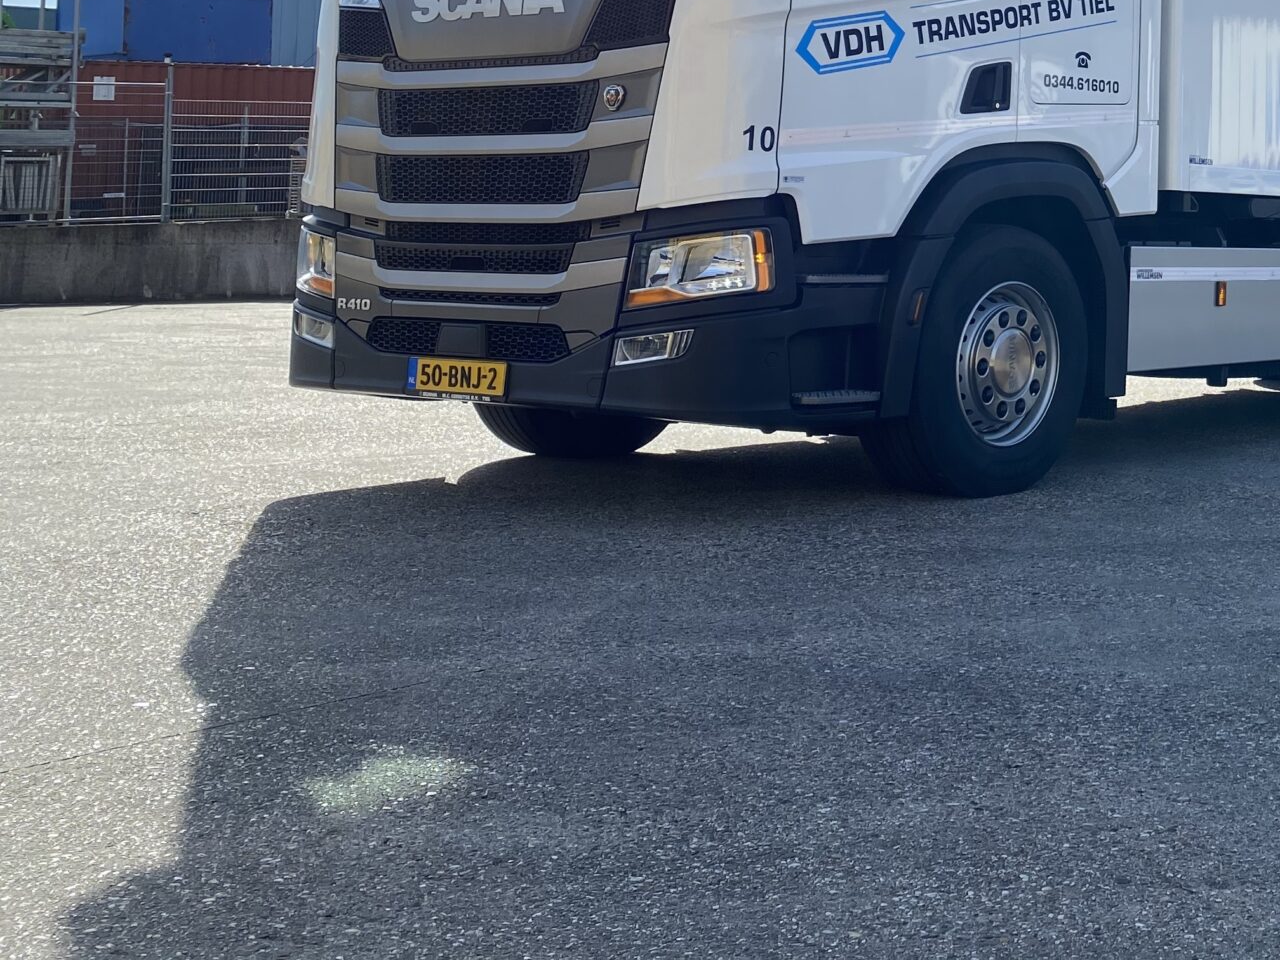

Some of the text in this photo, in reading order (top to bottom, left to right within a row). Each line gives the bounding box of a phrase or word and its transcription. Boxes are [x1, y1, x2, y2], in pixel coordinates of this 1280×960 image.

[912, 1, 1042, 45] TRANSPORT
[820, 24, 885, 60] VDH
[1043, 73, 1120, 94] 0344.616010
[742, 125, 775, 152] 10
[419, 363, 498, 391] 50-BNJ-2
